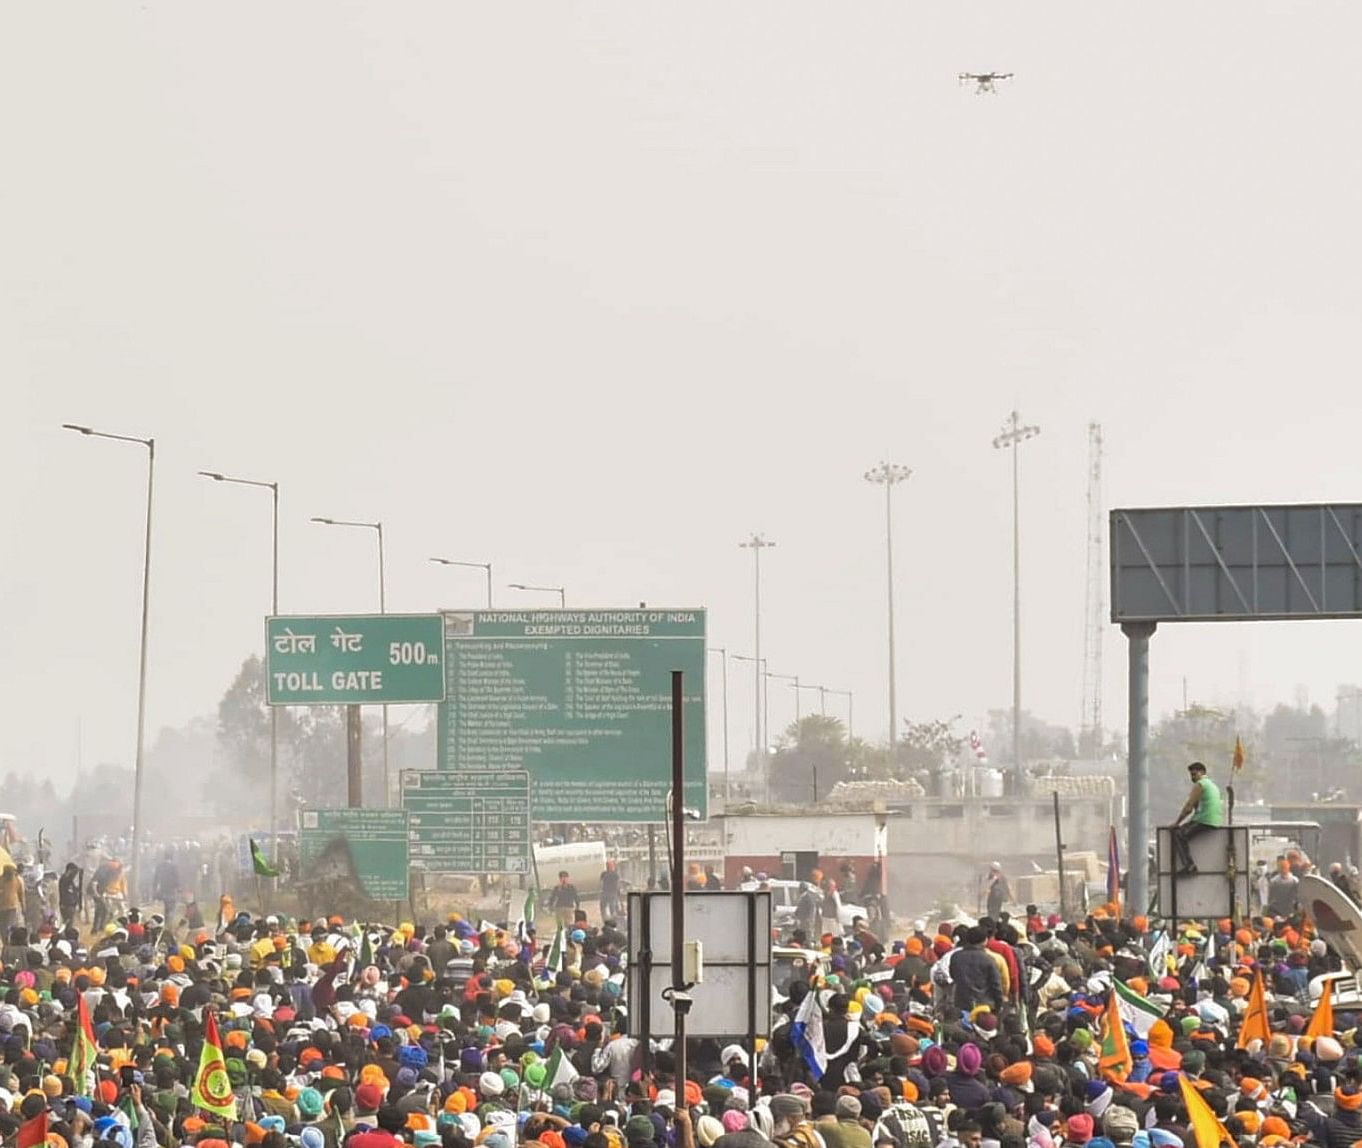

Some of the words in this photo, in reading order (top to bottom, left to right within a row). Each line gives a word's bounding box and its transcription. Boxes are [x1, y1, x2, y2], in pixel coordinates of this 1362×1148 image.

[478, 613, 530, 623] NATIONAL
[531, 612, 586, 623] HIGHWAYS
[588, 612, 648, 623] AUTHORITY
[649, 613, 665, 623] OF
[667, 613, 696, 623] INDIA
[524, 625, 581, 635] EXEMPTED
[583, 625, 650, 635] DIGNITARIES
[273, 627, 316, 654] टोल
[330, 626, 364, 653] गेट
[274, 672, 324, 691] TOLL
[331, 671, 383, 691] GATE
